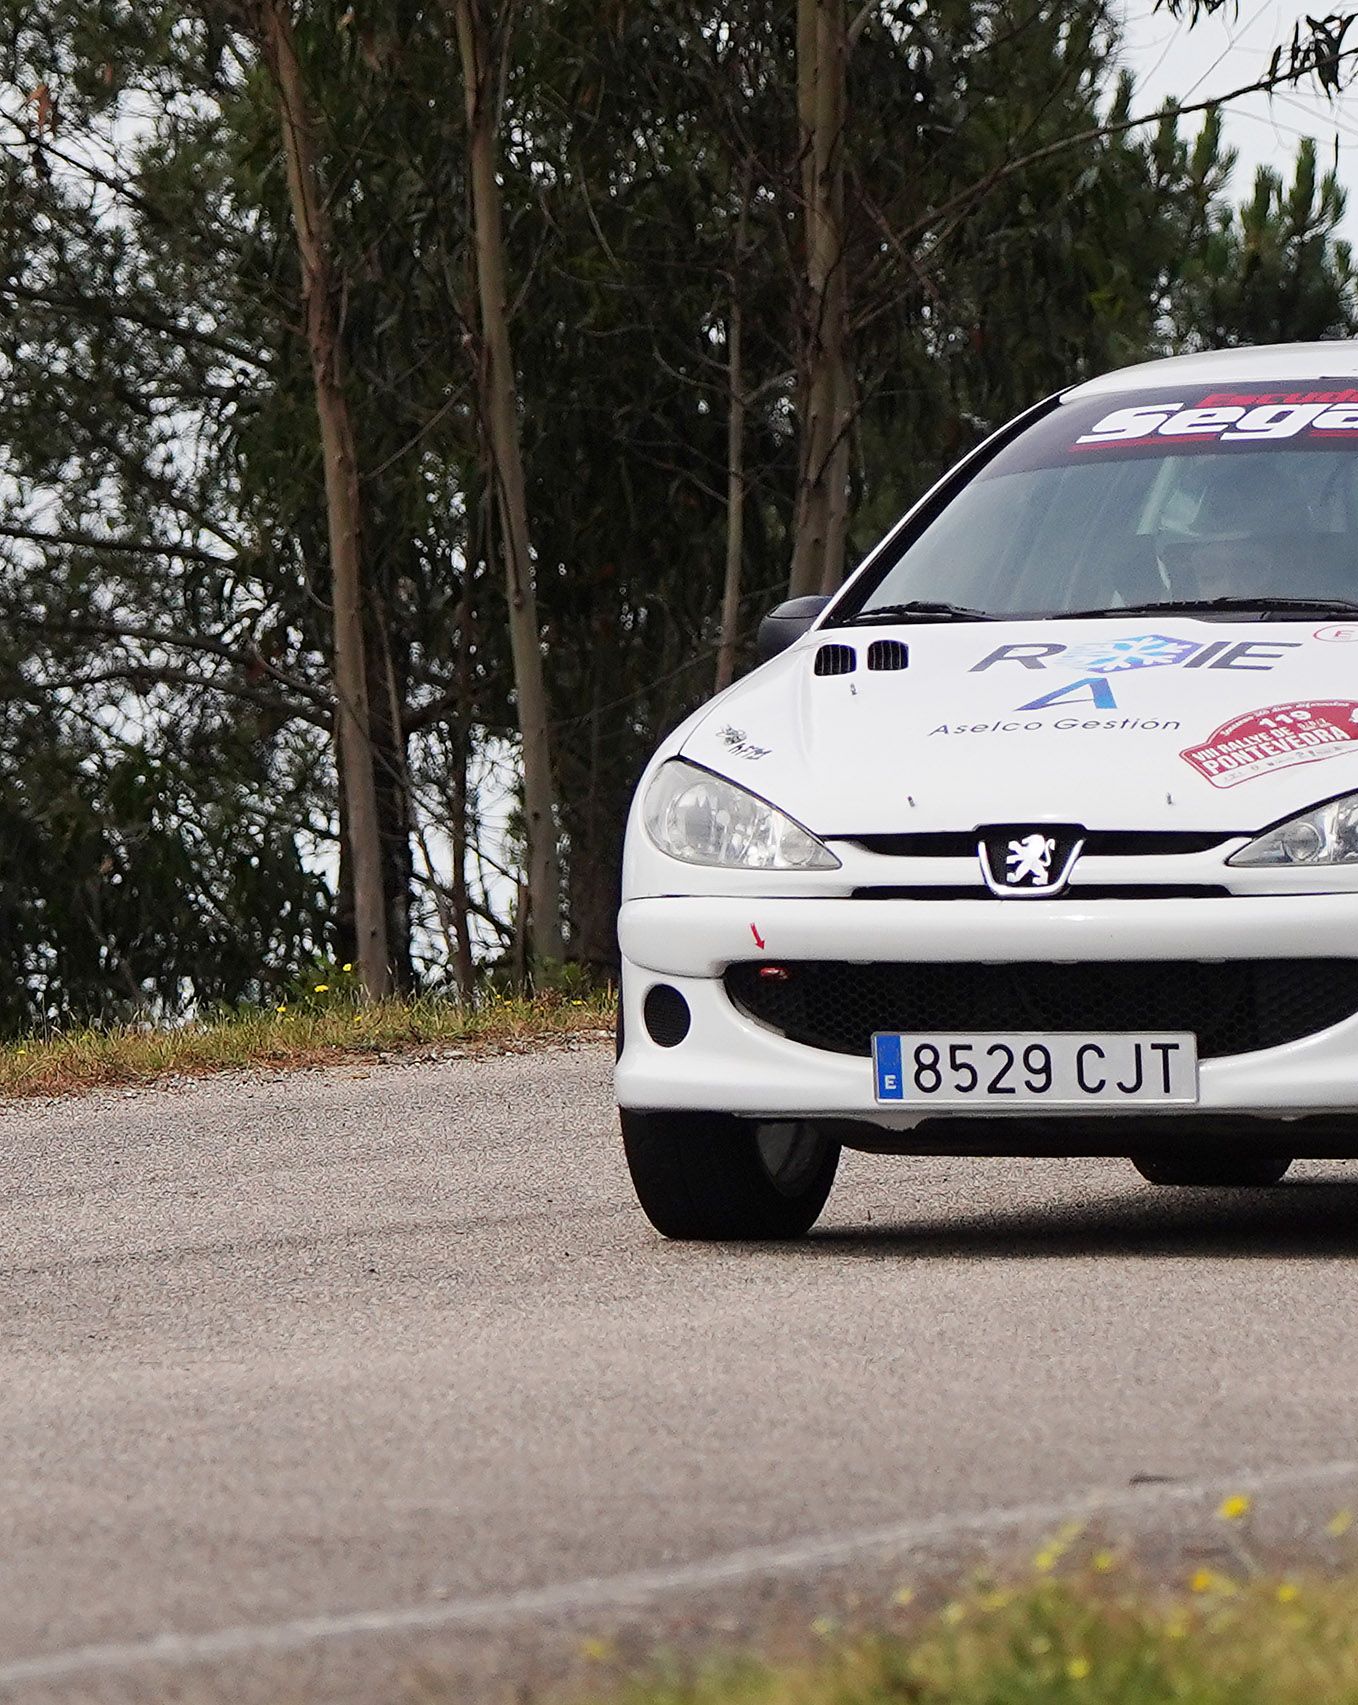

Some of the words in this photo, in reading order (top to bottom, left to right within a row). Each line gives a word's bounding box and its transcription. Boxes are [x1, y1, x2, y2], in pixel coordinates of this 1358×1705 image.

[928, 719, 1042, 736] Aselco
[1053, 717, 1181, 732] Gestión
[1259, 710, 1312, 728] 119
[1202, 725, 1351, 775] PONTEVEDRA
[1217, 731, 1272, 753] RALLYE
[1270, 726, 1295, 738] DE
[884, 1075, 896, 1090] E
[913, 1043, 1053, 1094] 8529
[1076, 1043, 1180, 1094] CJT
